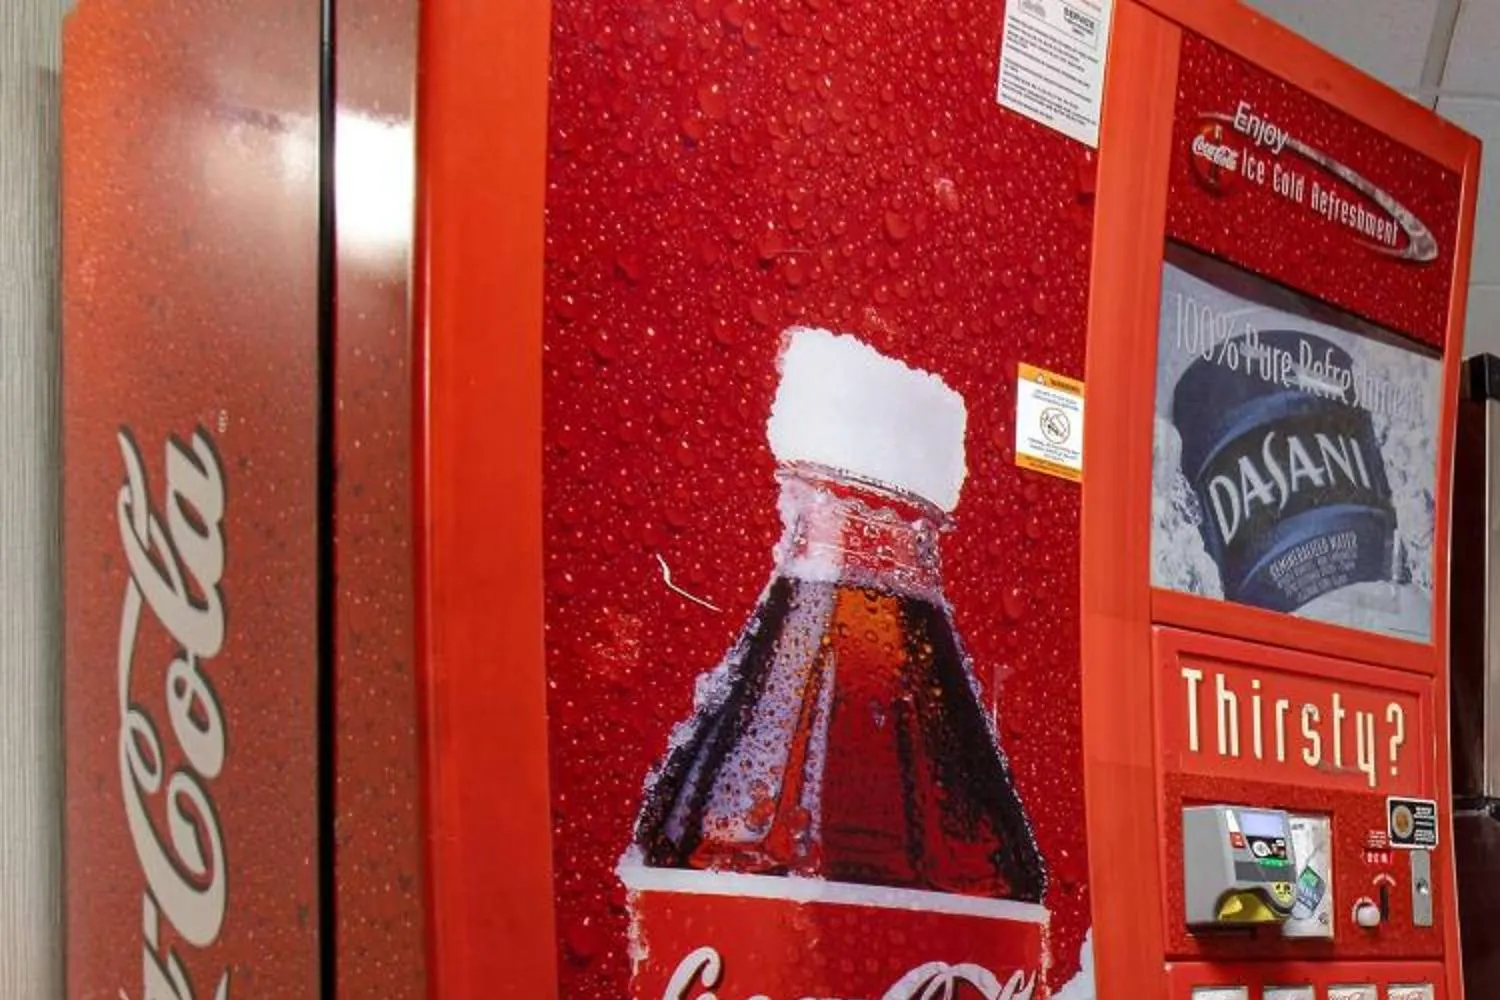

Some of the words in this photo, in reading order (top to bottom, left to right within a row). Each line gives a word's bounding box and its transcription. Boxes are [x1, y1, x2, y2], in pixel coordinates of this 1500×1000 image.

[1232, 100, 1290, 155] Enjoy
[1241, 147, 1265, 184] Ice
[1273, 163, 1305, 203] Cold
[1310, 181, 1399, 247] Refreshment
[1176, 294, 1239, 371] 100%
[1245, 323, 1292, 388] Pure
[1207, 431, 1372, 546] DASANI
[1181, 667, 1405, 788] Thirsty?
